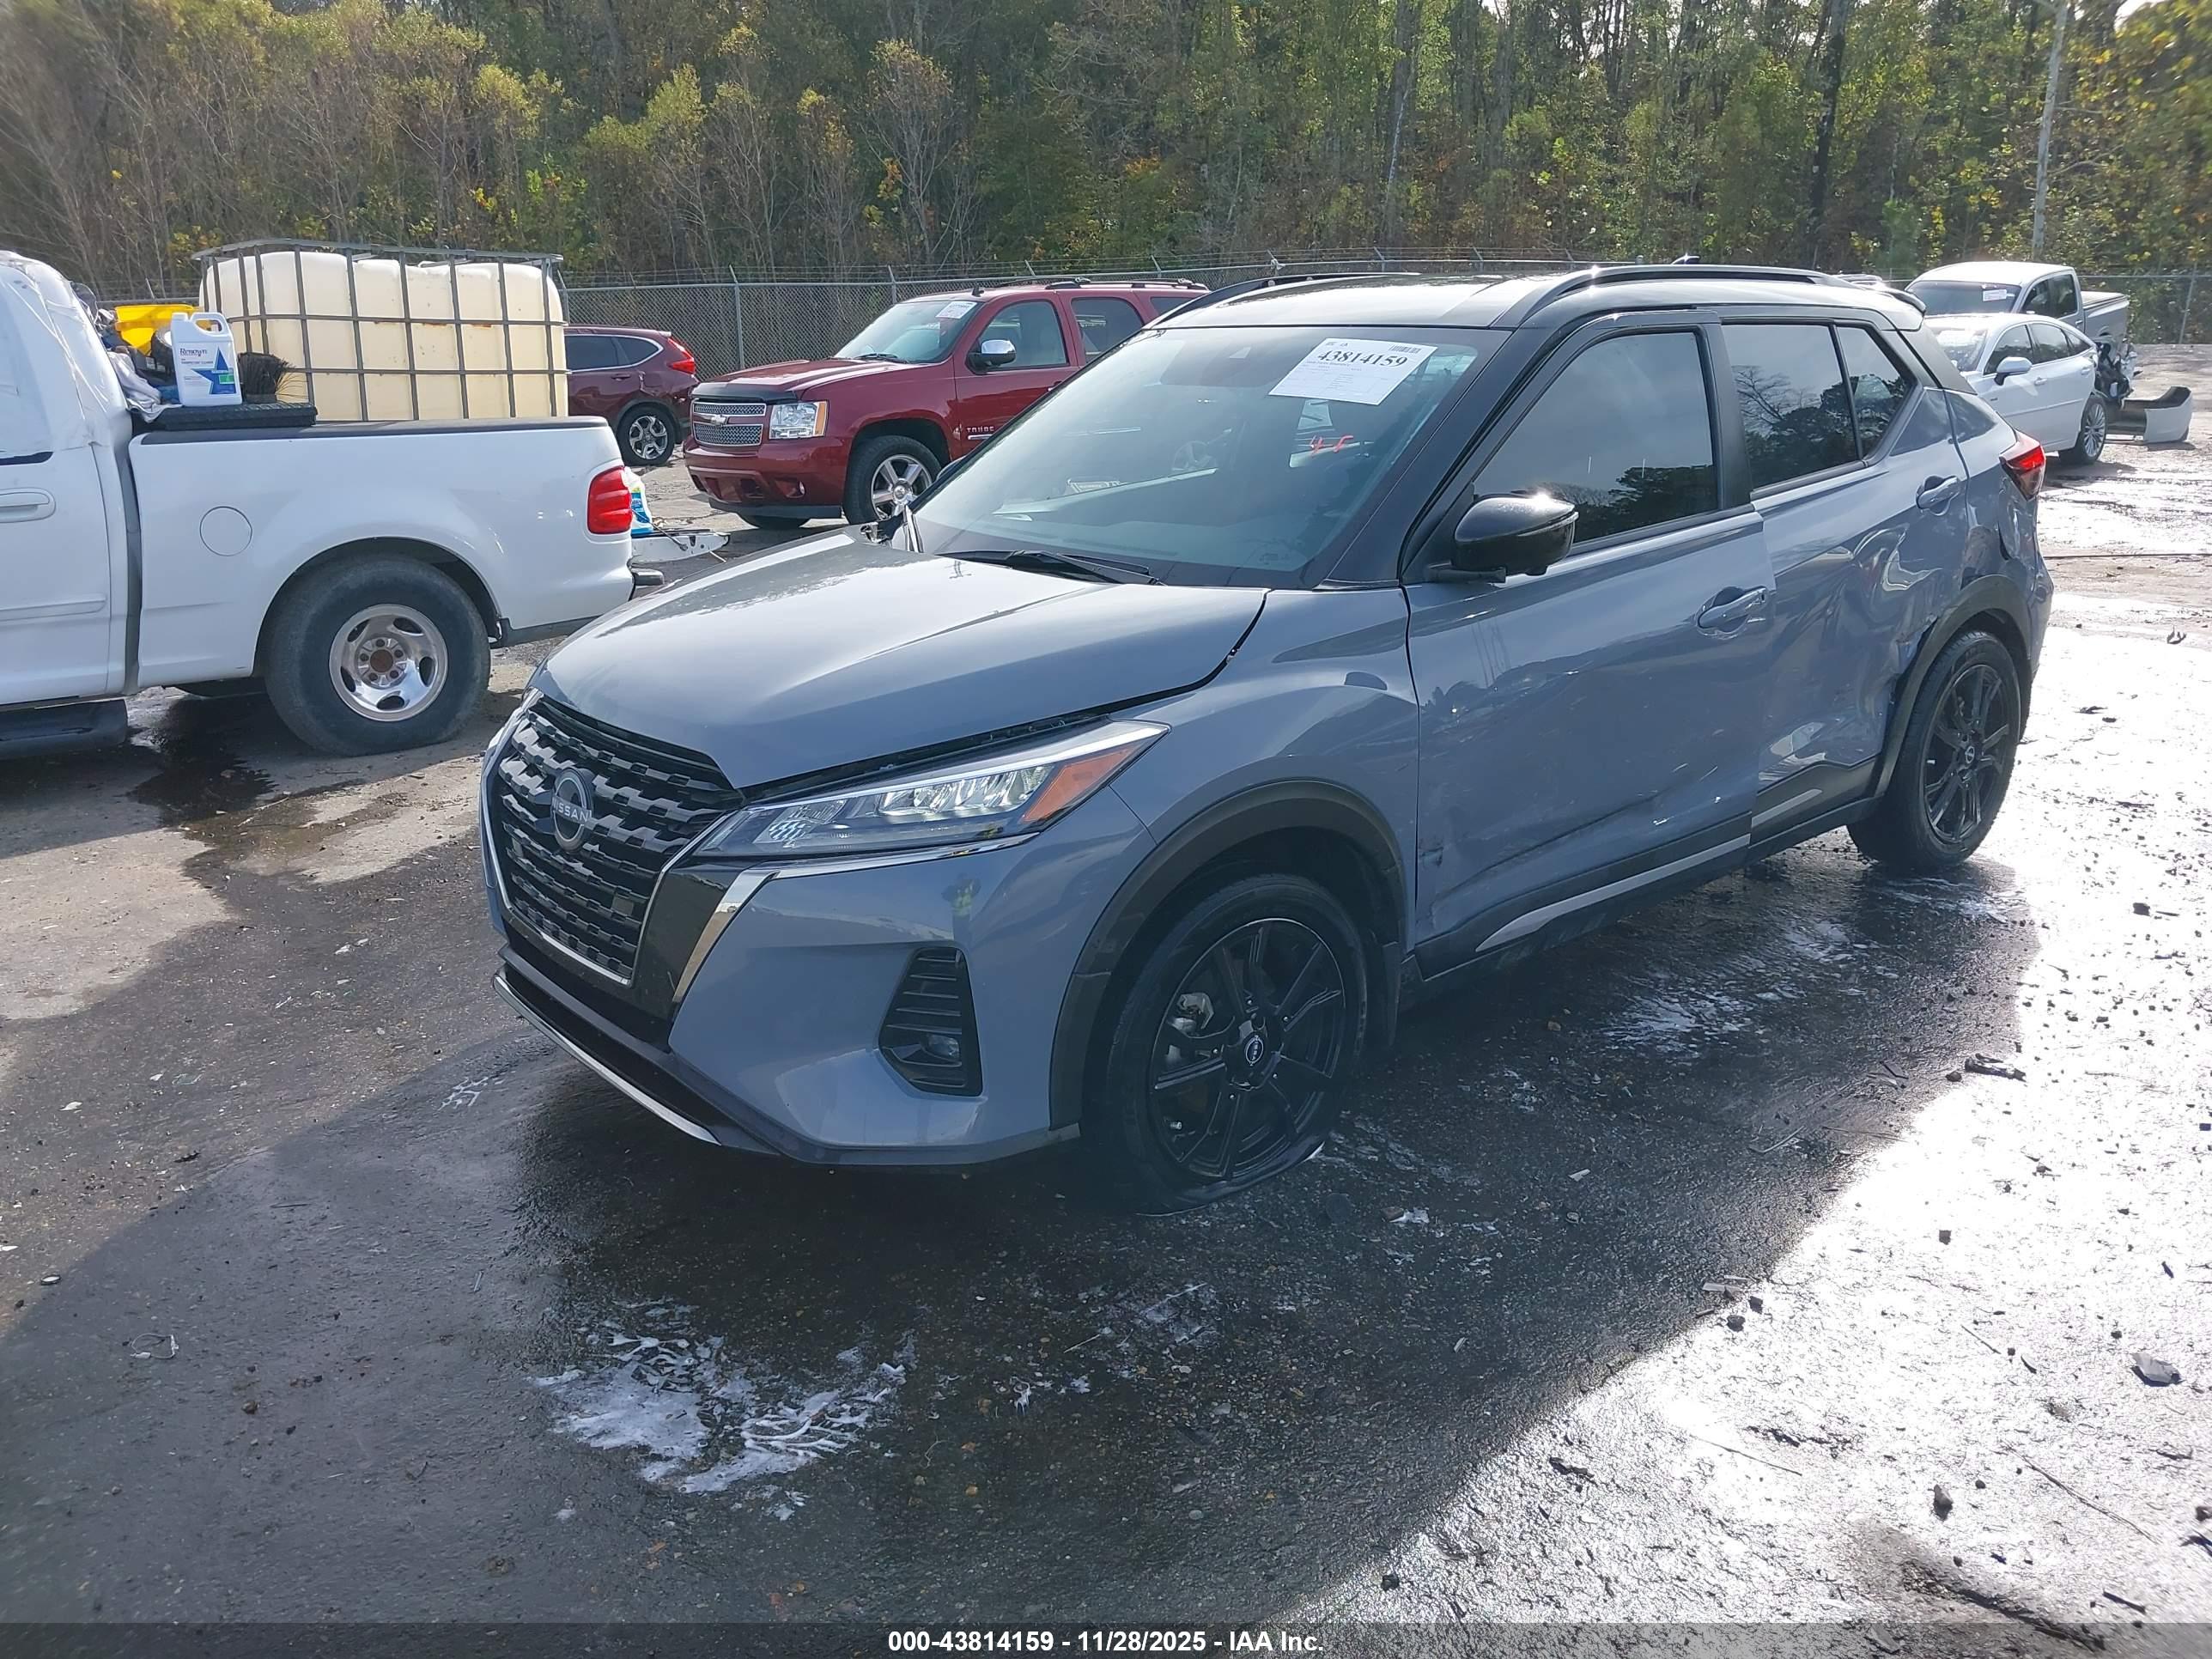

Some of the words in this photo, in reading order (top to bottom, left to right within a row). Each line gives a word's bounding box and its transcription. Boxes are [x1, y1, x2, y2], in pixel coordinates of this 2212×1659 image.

[179, 348, 208, 356] Renown
[1318, 350, 1408, 368] 43814159
[552, 797, 589, 822] NISSAN
